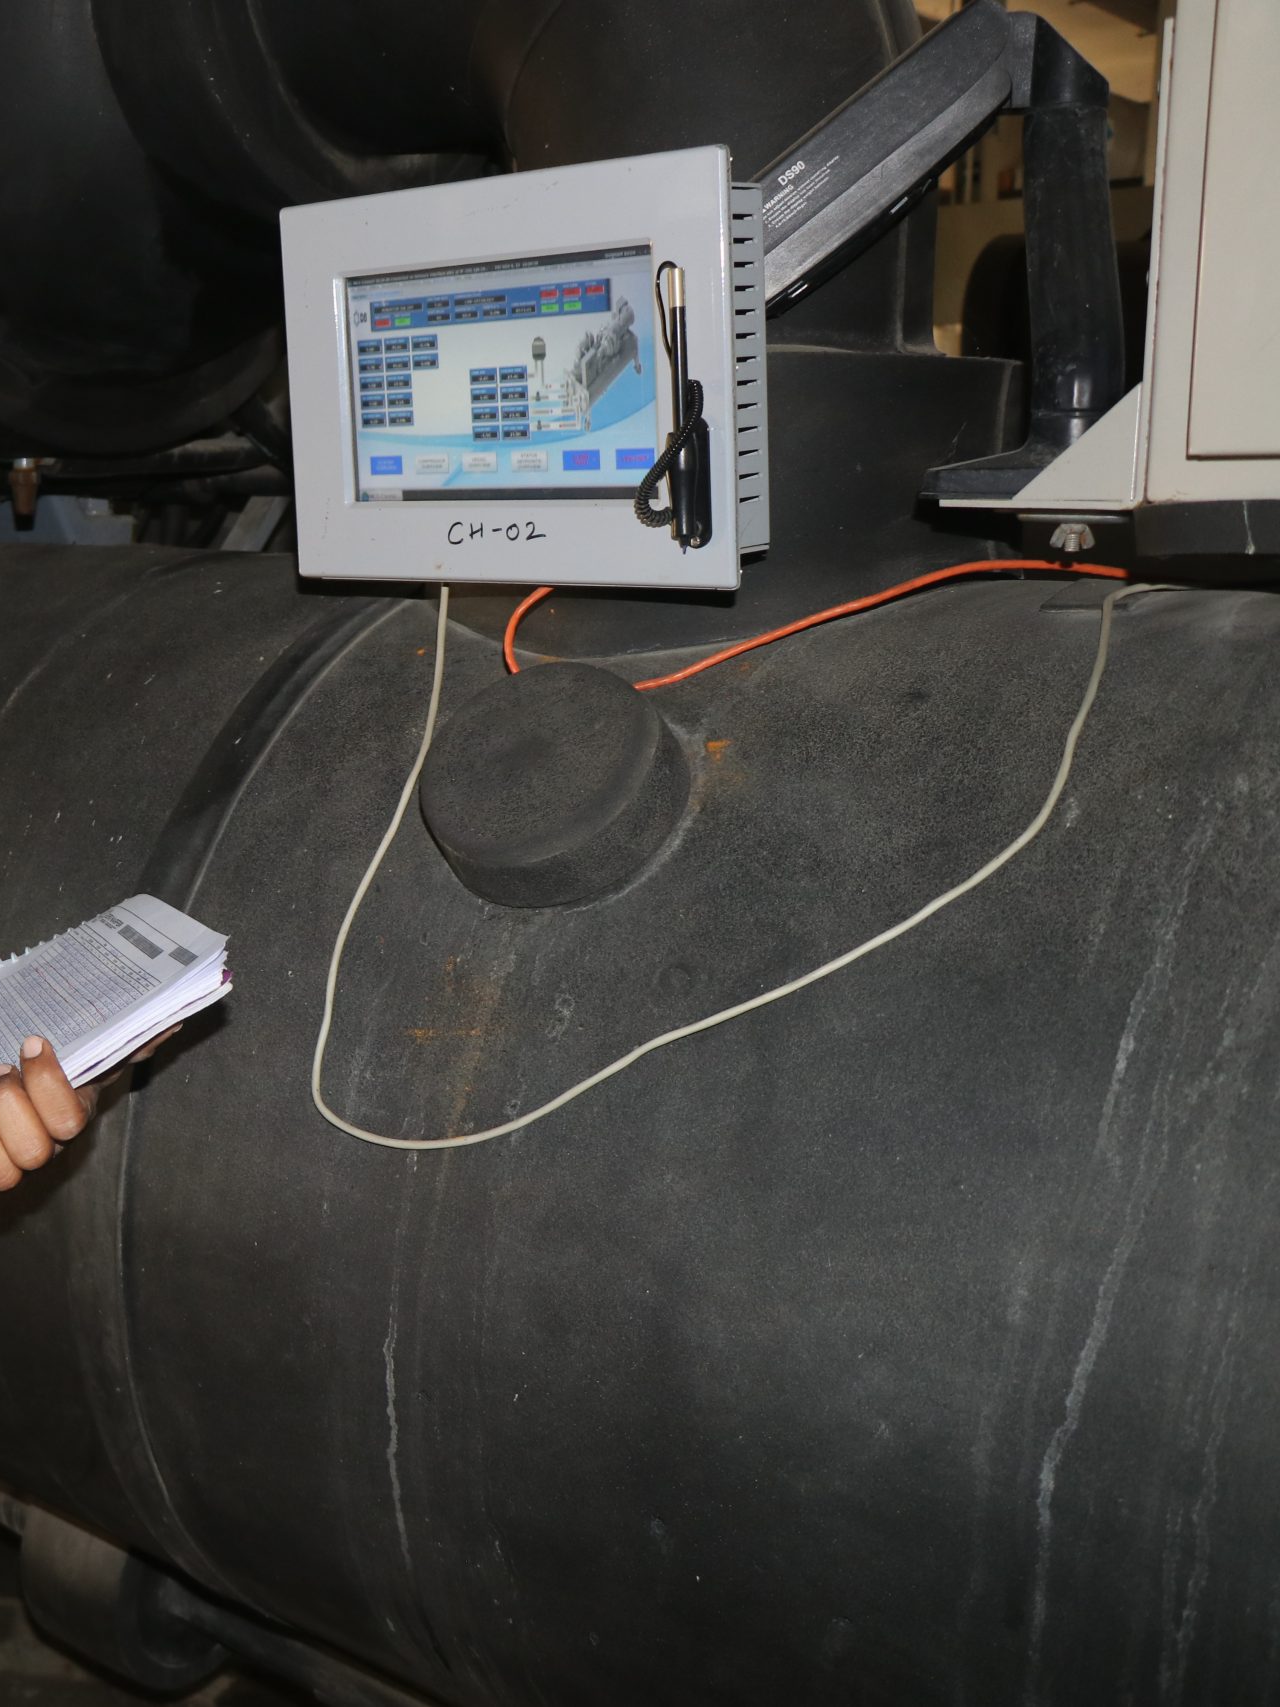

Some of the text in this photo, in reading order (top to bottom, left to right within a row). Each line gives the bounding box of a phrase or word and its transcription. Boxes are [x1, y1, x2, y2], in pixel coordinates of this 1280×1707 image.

[778, 160, 805, 186] DS90
[764, 184, 794, 209] WARNING
[448, 522, 546, 545] CH-02
